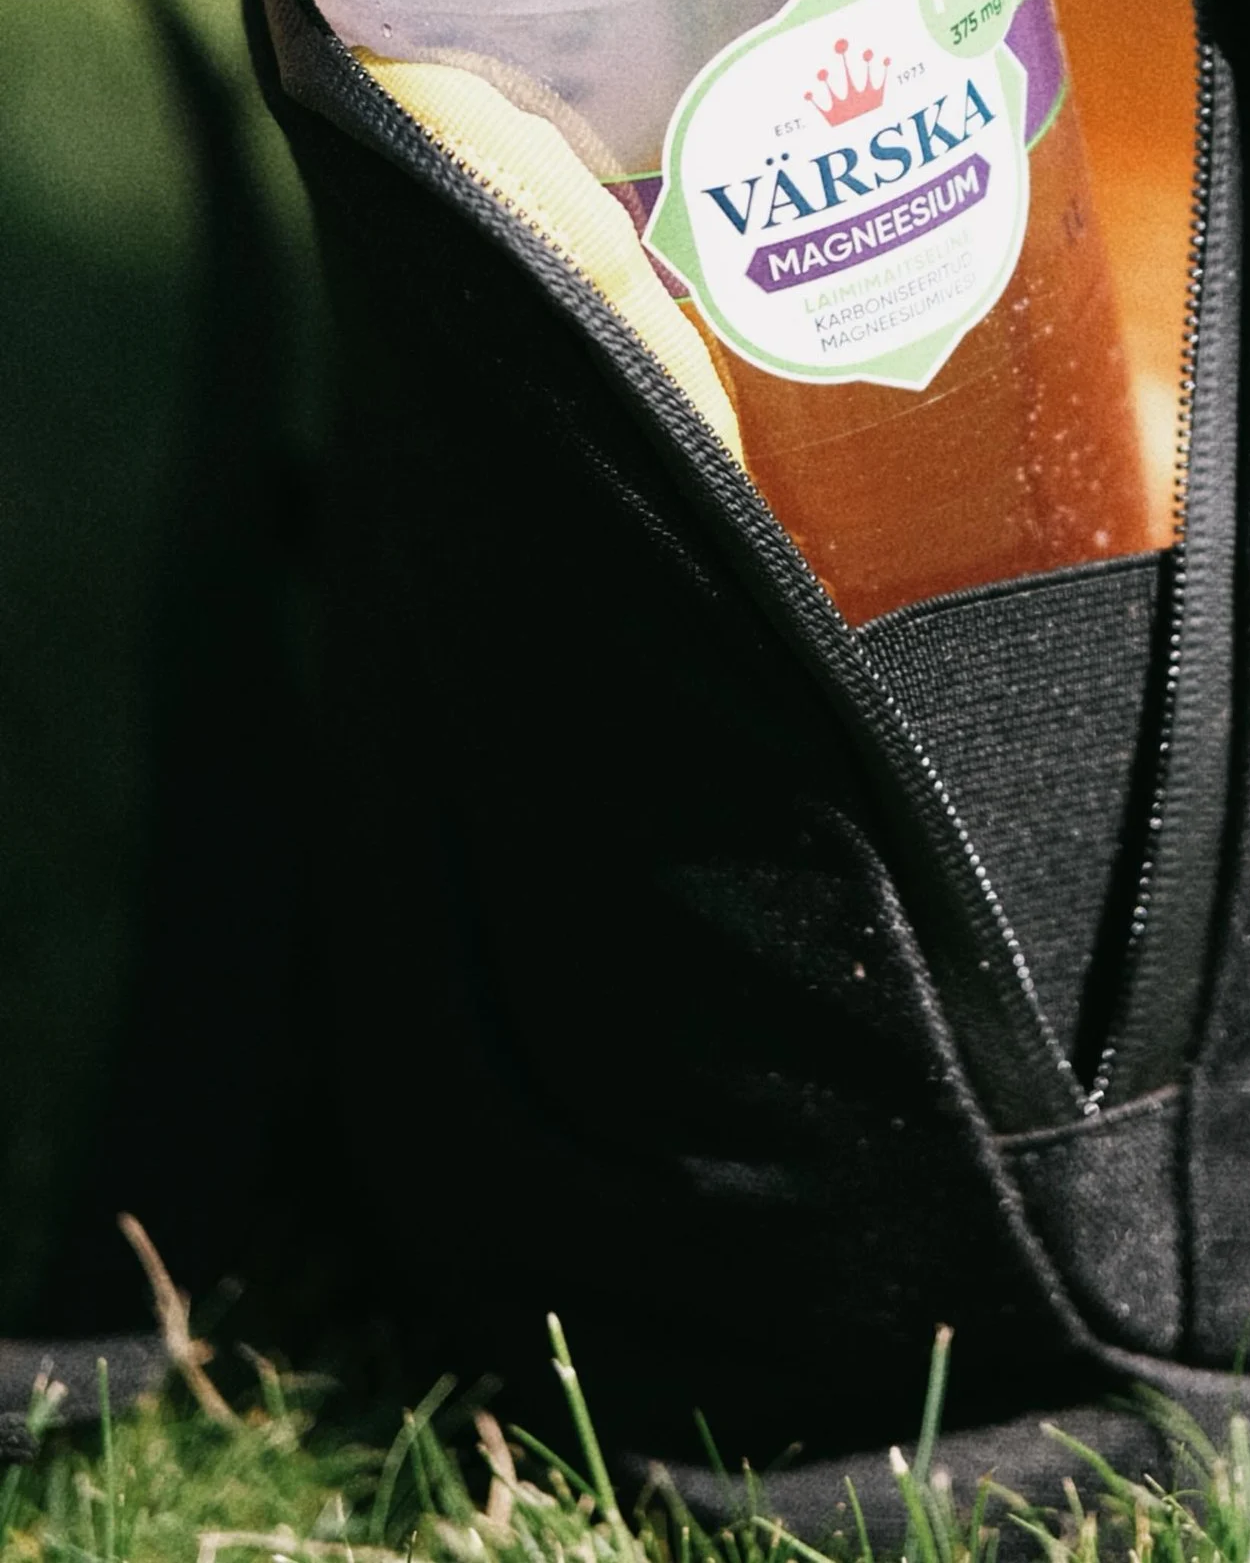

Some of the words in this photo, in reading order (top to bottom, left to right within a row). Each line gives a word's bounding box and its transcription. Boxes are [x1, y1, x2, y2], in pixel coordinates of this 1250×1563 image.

[950, 10, 978, 45] 375
[774, 118, 806, 137] EST.
[897, 62, 926, 85] 1973
[700, 77, 997, 236] VÄRSKA
[767, 164, 980, 282] MAGNEESIUM
[814, 251, 973, 333] KARBONISEERITUD
[820, 272, 977, 353] MAGNEESIUMIVESI
